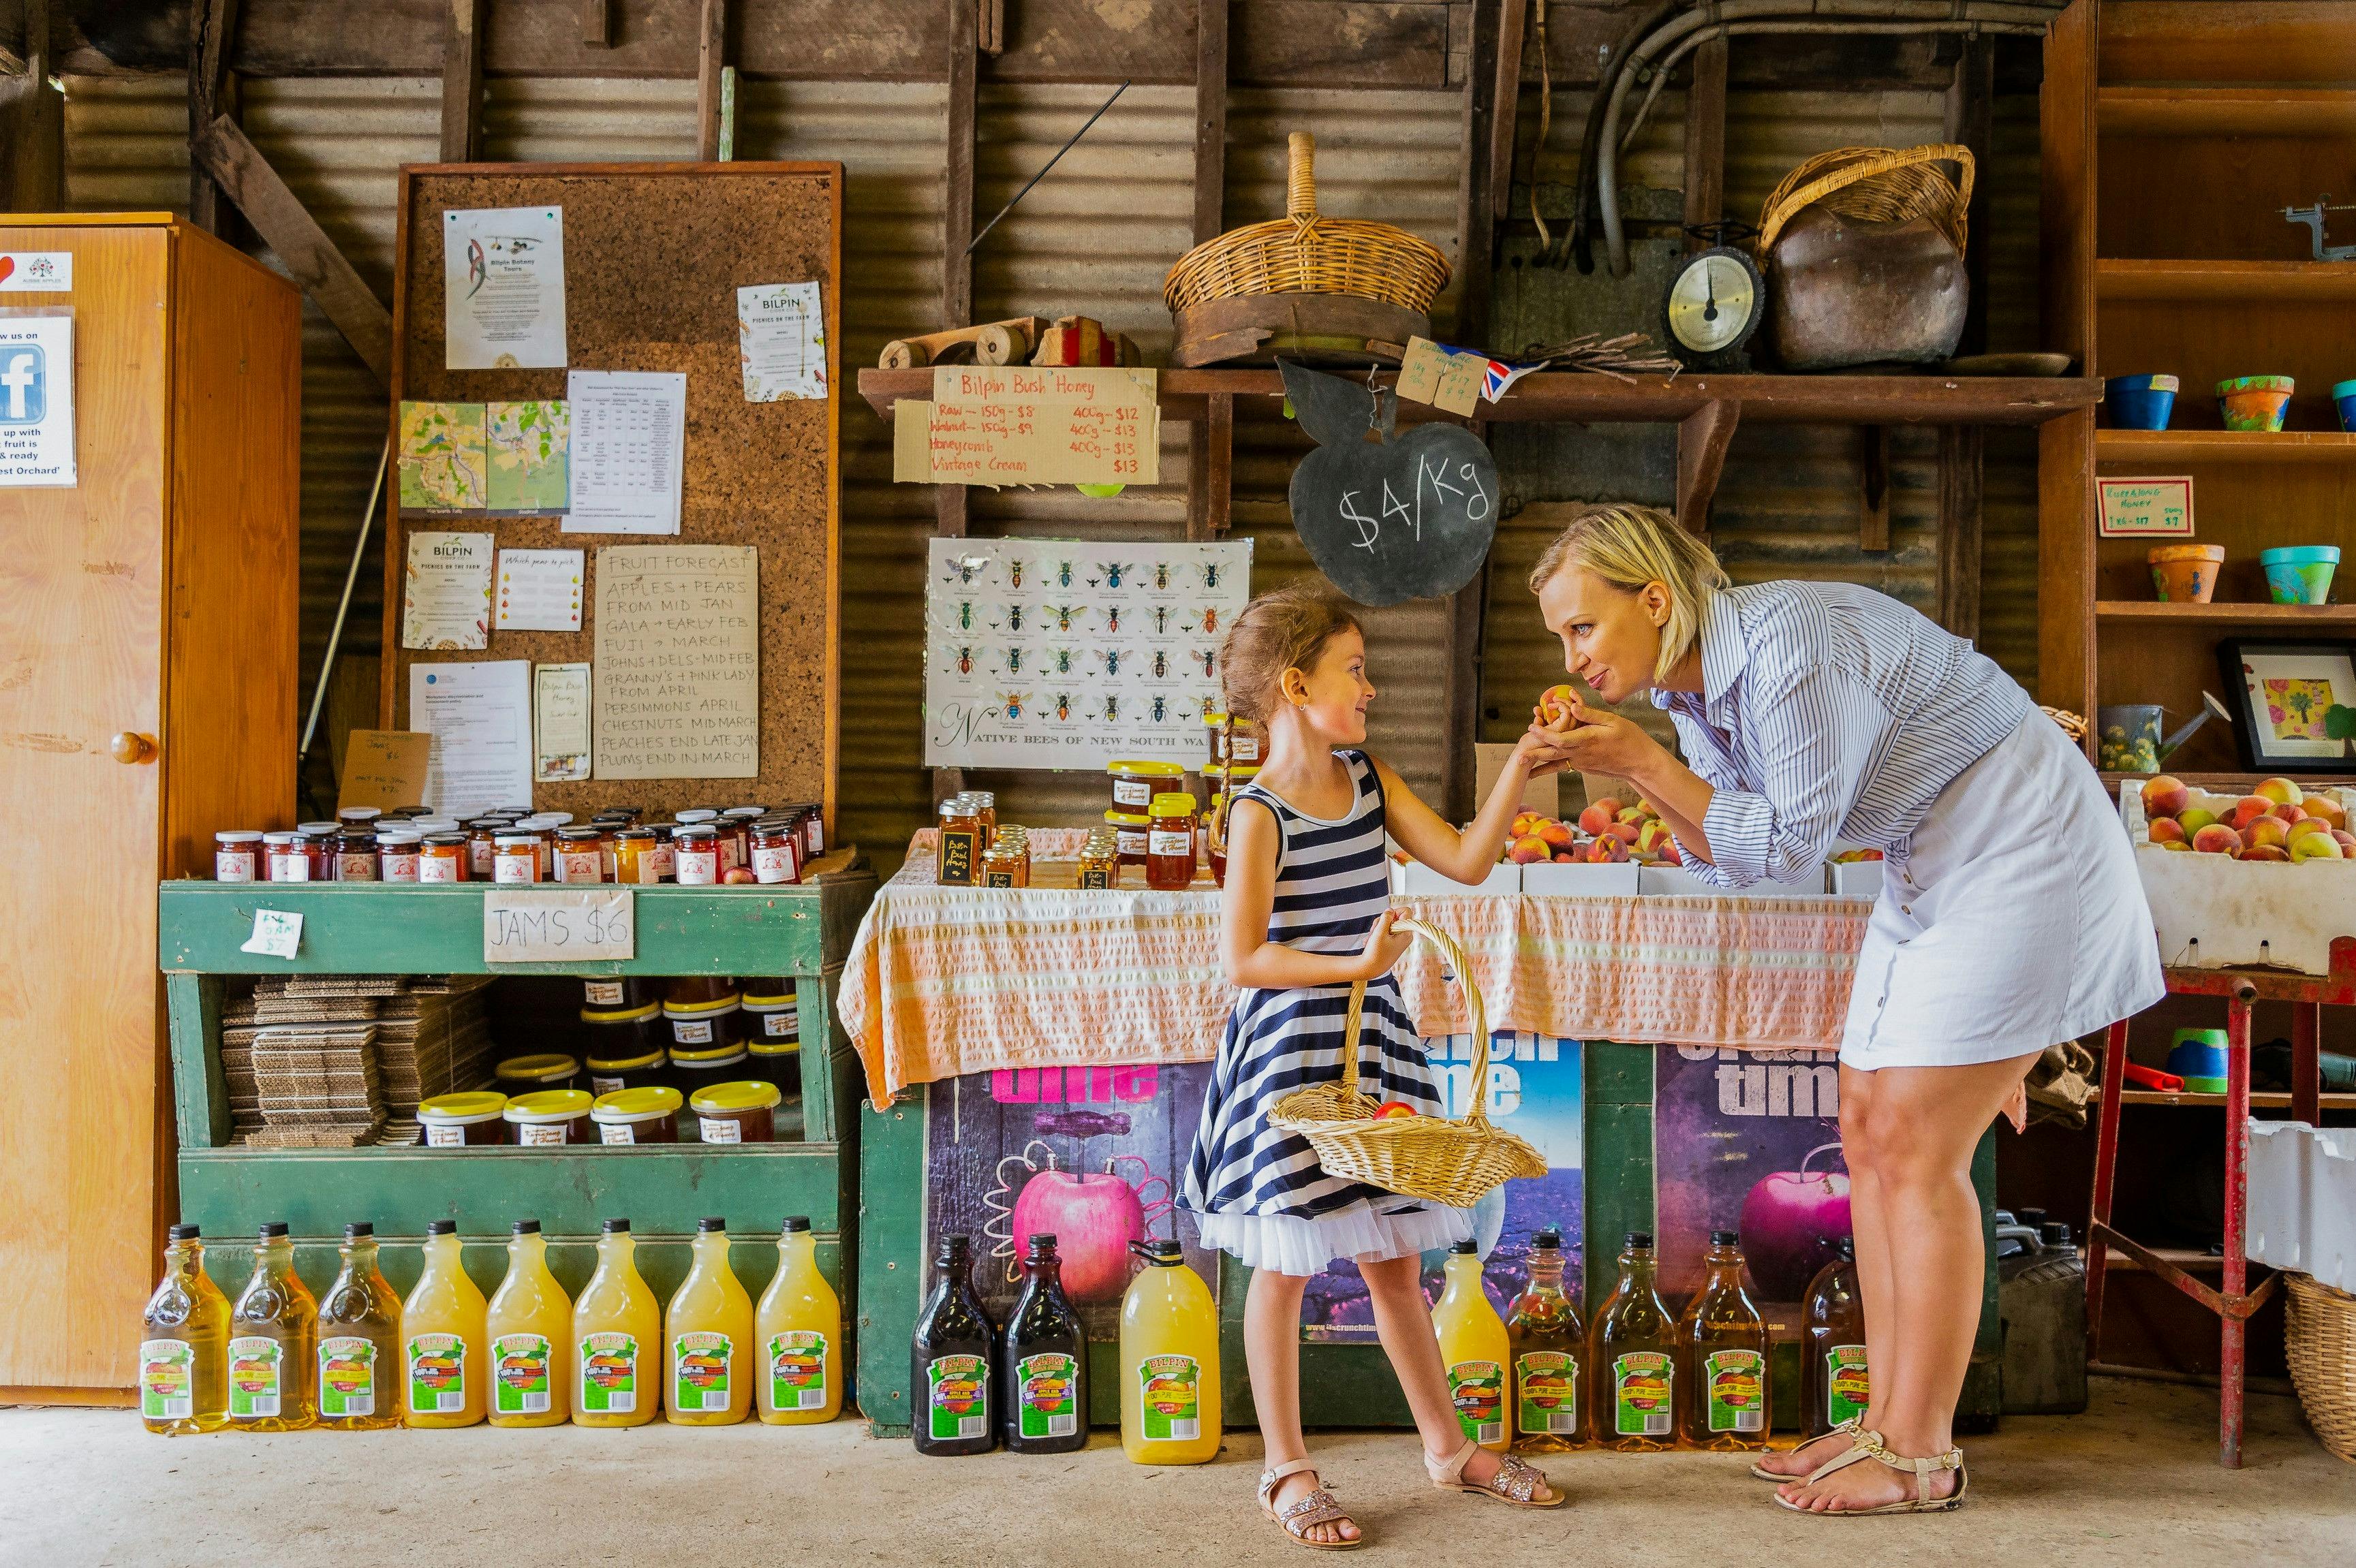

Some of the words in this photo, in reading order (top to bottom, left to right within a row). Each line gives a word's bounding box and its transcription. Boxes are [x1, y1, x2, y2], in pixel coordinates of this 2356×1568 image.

[762, 299, 800, 309] BILPIN
[961, 375, 1005, 400] Bilpin
[1014, 375, 1047, 394] Bush
[1056, 375, 1095, 401] Honey
[939, 404, 963, 416] Raw
[4, 430, 16, 439] up
[929, 438, 993, 456] Honeycomb
[10, 452, 38, 460] ready
[932, 456, 981, 477] Vintage
[988, 456, 1027, 472] Cream
[1114, 459, 1138, 474] $13
[434, 546, 472, 556] BILPIN
[506, 556, 530, 565] Which
[608, 556, 659, 573] FRUIT
[666, 556, 750, 569] FORECAST
[606, 581, 675, 598] APPLES
[695, 580, 747, 594] PEARS
[606, 600, 653, 616] FROM
[661, 599, 690, 612] MID
[700, 598, 733, 610] JAN
[606, 619, 650, 634] GALA
[667, 617, 714, 631] EARLY
[719, 616, 749, 628] FEB
[604, 638, 644, 653] FUJI
[672, 636, 730, 648] MARCH
[602, 656, 645, 670] JOHNS
[702, 653, 726, 665] MID
[730, 653, 755, 665] FEB
[604, 670, 673, 686] GRANNY'S
[690, 670, 721, 682] PINK
[724, 670, 755, 685] LADY
[610, 687, 650, 700] FROM
[657, 685, 698, 697] APRIL
[605, 701, 692, 716] PERSIMMONS
[700, 699, 742, 712] APRIL
[602, 718, 683, 733] CHESTNUTS
[692, 718, 716, 730] MID
[719, 716, 756, 729] MARCH
[933, 702, 1018, 748] NATIVE
[1023, 735, 1059, 744] BEES
[1065, 736, 1084, 745] OF
[1091, 737, 1123, 745] NEW
[1130, 737, 1176, 746] SOUTH
[600, 736, 664, 751] PEACHES
[670, 736, 698, 748] END
[703, 735, 733, 747] LATE
[734, 734, 758, 747] JAN
[600, 753, 642, 771] PLUMS
[647, 753, 676, 765] END
[681, 752, 698, 764] IN
[702, 751, 750, 765] MARCH
[946, 858, 967, 869] Honey
[490, 909, 570, 946] JAMS
[584, 905, 629, 945] $6
[1714, 1065, 1839, 1116] tim
[328, 1340, 362, 1349] BILPIN
[418, 1337, 453, 1346] BILPIN
[502, 1338, 538, 1346] BILPIN
[591, 1336, 627, 1345] BILPIN
[684, 1335, 721, 1345] BILPIN
[779, 1334, 814, 1343] BILPIN
[146, 1342, 181, 1352] BILPIN
[1528, 1354, 1565, 1364] BILPIN
[1626, 1354, 1662, 1364] BILPIN
[1718, 1353, 1753, 1362] BILPIN
[1839, 1349, 1865, 1358] BILP
[938, 1357, 976, 1369] BILPIN
[1028, 1355, 1066, 1368] BILPIN
[1149, 1358, 1189, 1368] BILPIN
[1455, 1363, 1495, 1375] BILPIN
[1849, 1381, 1860, 1390] PURE
